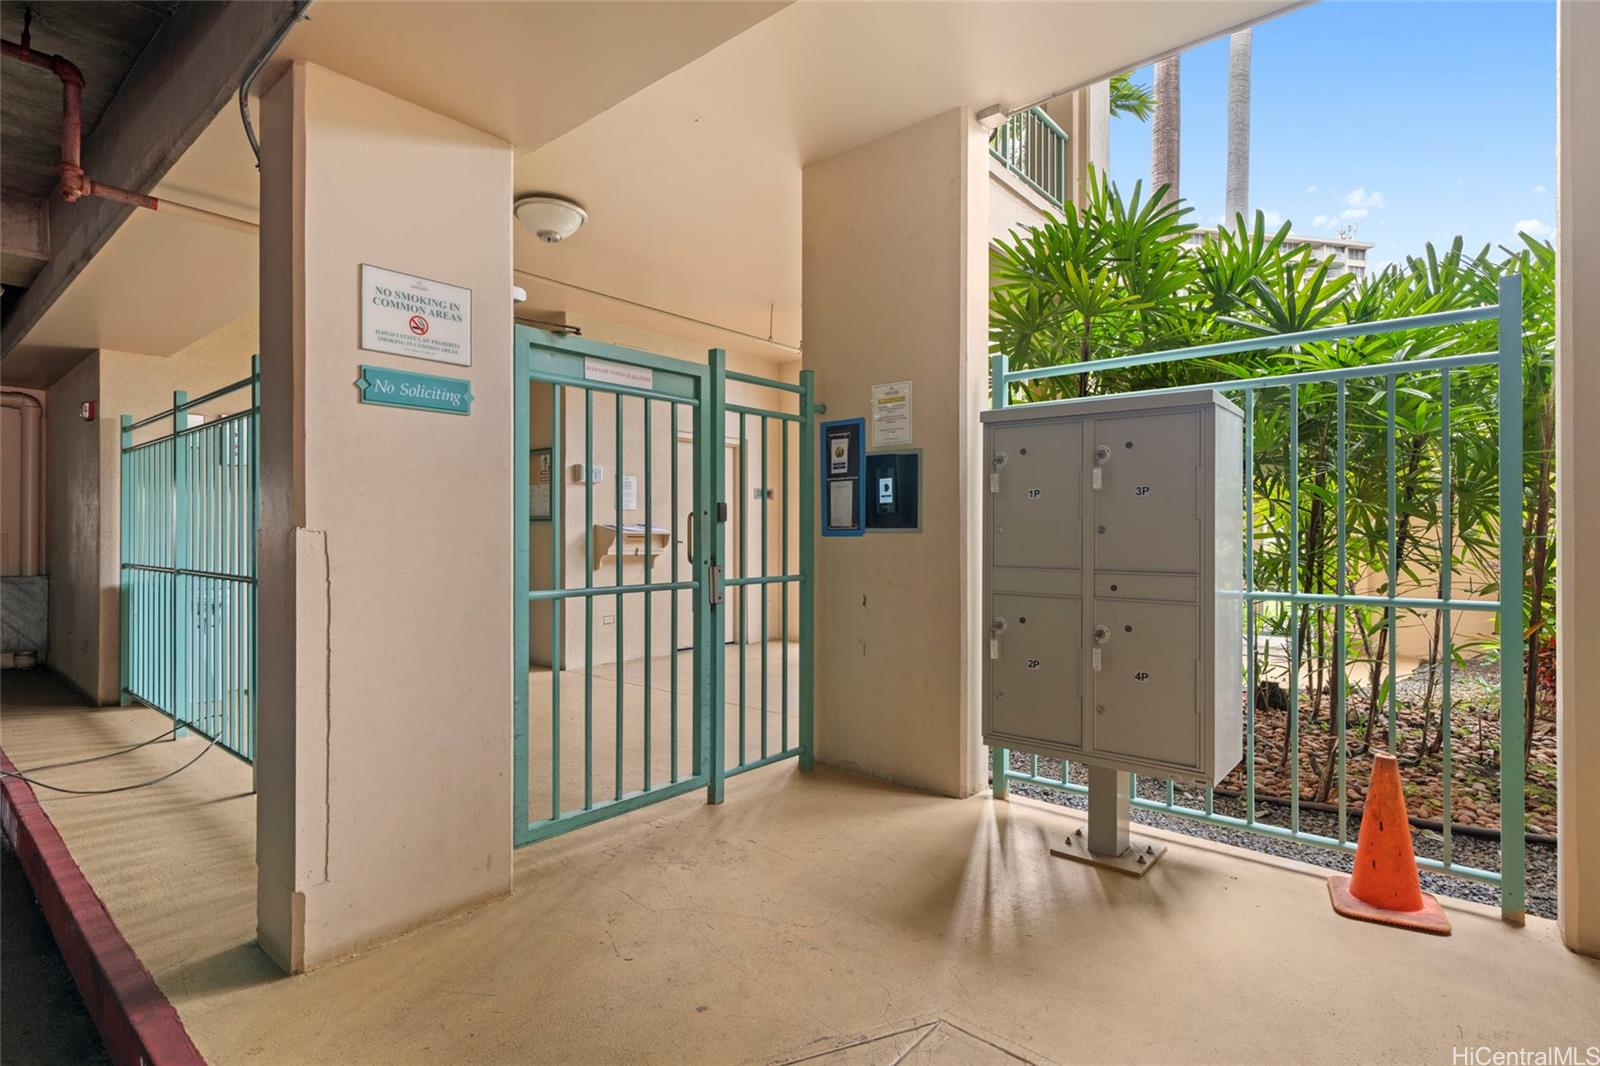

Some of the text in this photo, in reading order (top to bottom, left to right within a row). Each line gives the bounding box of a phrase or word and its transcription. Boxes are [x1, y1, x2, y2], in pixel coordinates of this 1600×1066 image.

[375, 286, 461, 312] NO SMOKING IN
[372, 296, 463, 323] COMMON AREAS
[377, 336, 406, 346] SMOKING
[413, 341, 440, 352] COMMON
[374, 379, 461, 406] No Soliciting
[1028, 489, 1040, 498] 1P
[1135, 486, 1150, 496] 3P
[1027, 660, 1040, 668] 2P
[1134, 672, 1149, 681] 4P
